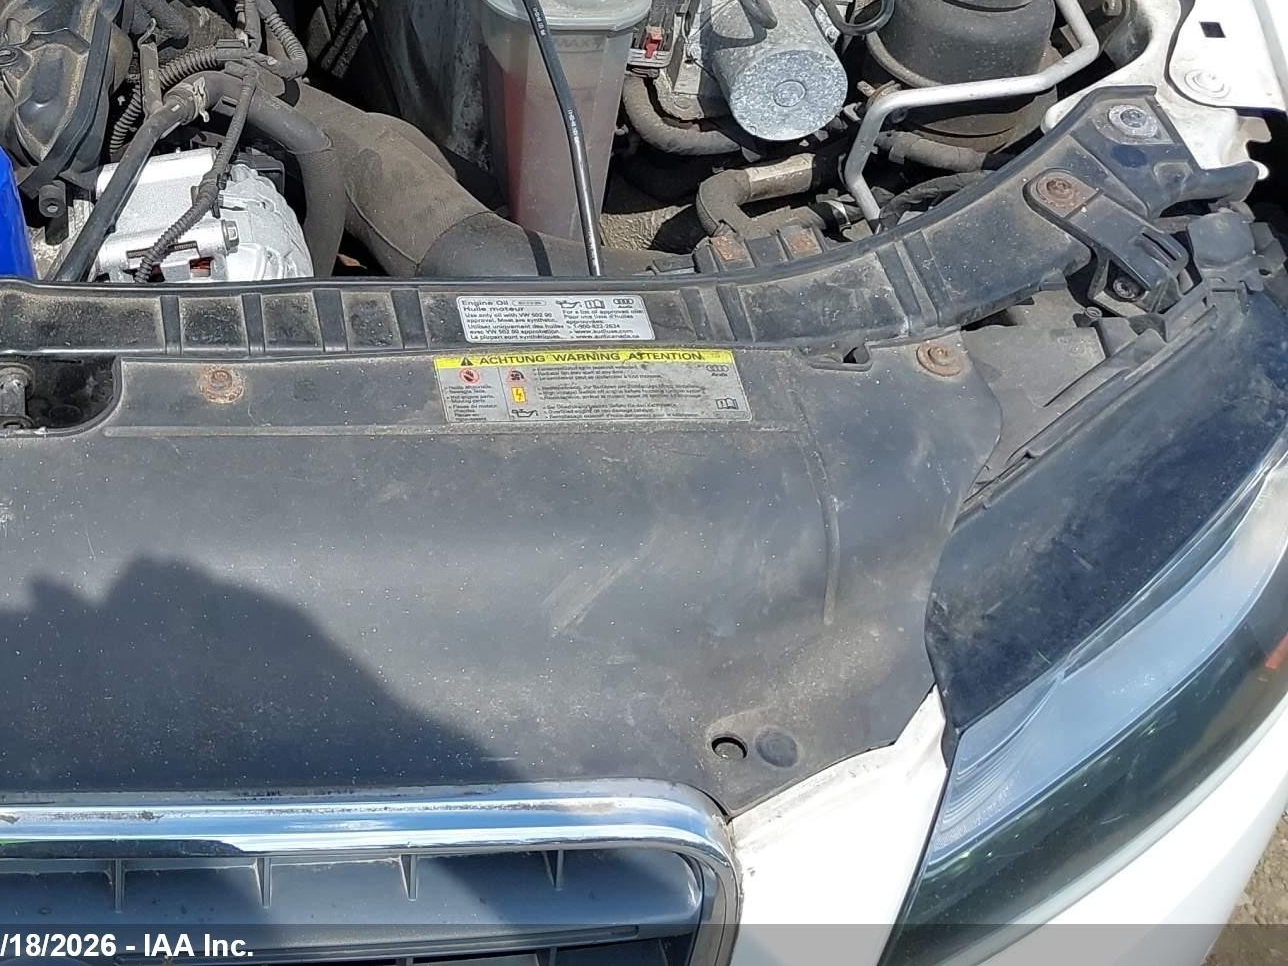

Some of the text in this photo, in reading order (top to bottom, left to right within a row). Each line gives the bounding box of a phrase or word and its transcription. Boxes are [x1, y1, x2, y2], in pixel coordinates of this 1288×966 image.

[479, 352, 702, 365] ACHTUNG WARNING ATTENTION
